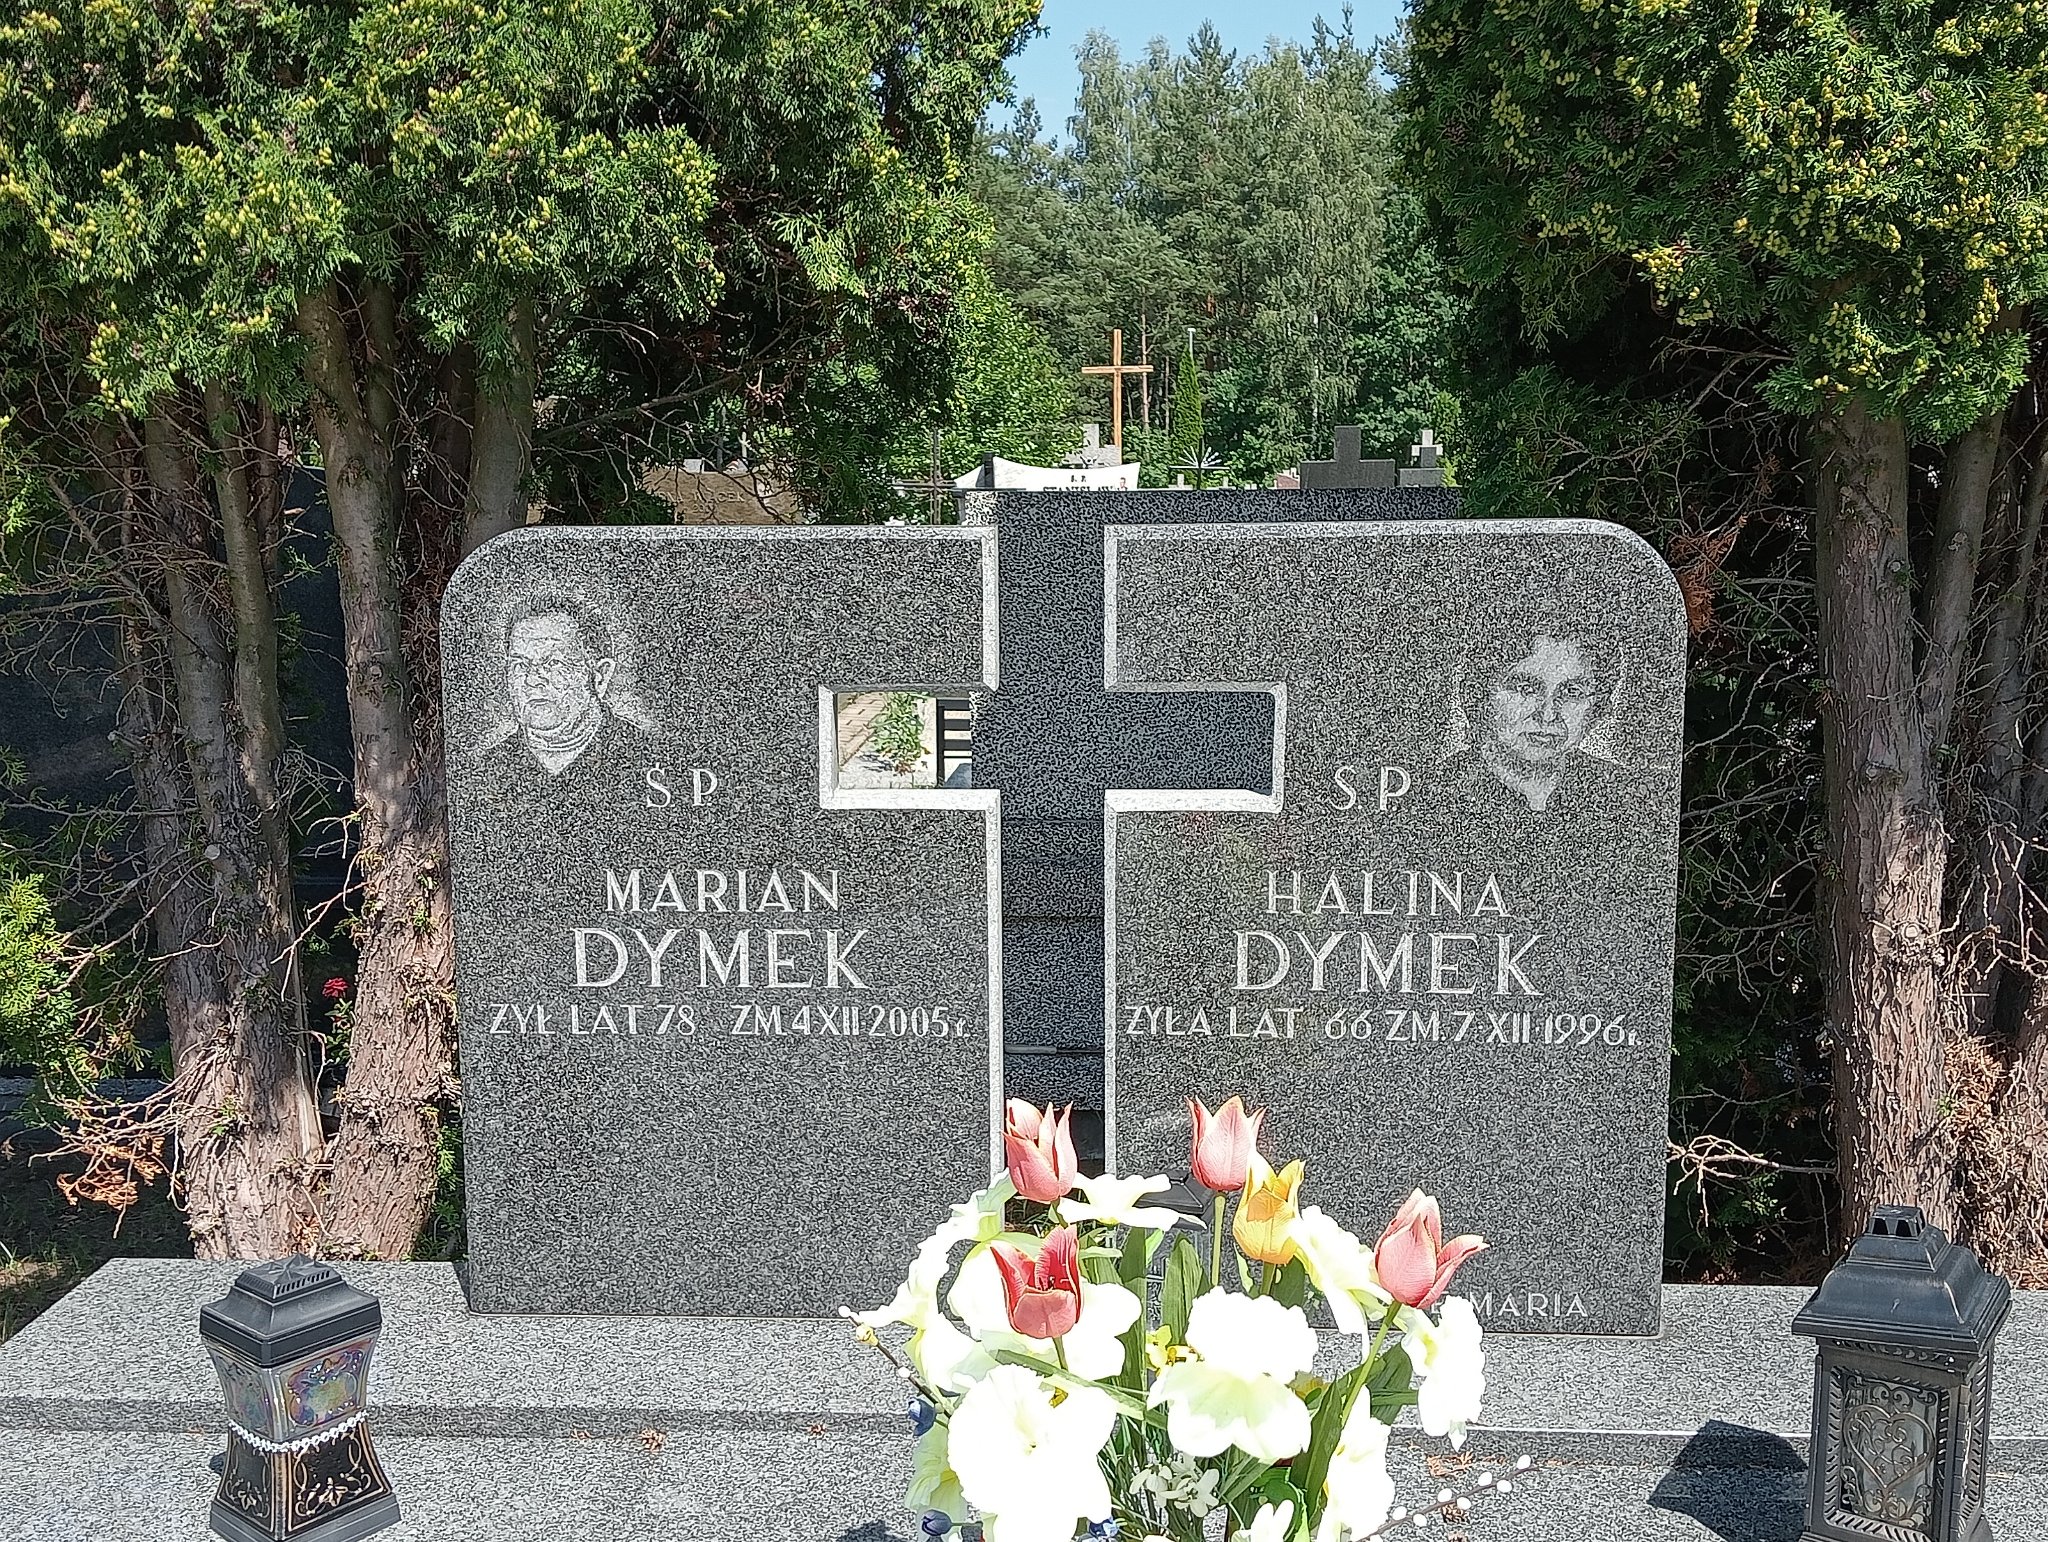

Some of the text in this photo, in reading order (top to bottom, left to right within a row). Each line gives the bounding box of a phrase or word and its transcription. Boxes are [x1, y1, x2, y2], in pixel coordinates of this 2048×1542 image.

[604, 868, 841, 913] MARIAN
[1266, 868, 1514, 918] HALINA
[568, 926, 871, 989] DYMEK
[1231, 929, 1545, 997] DYMEK
[570, 1003, 645, 1035] LAT
[654, 1003, 697, 1036] 78
[1228, 1005, 1304, 1039] LAT
[1324, 1005, 1373, 1041] 66
[1468, 1289, 1589, 1319] MARIA
